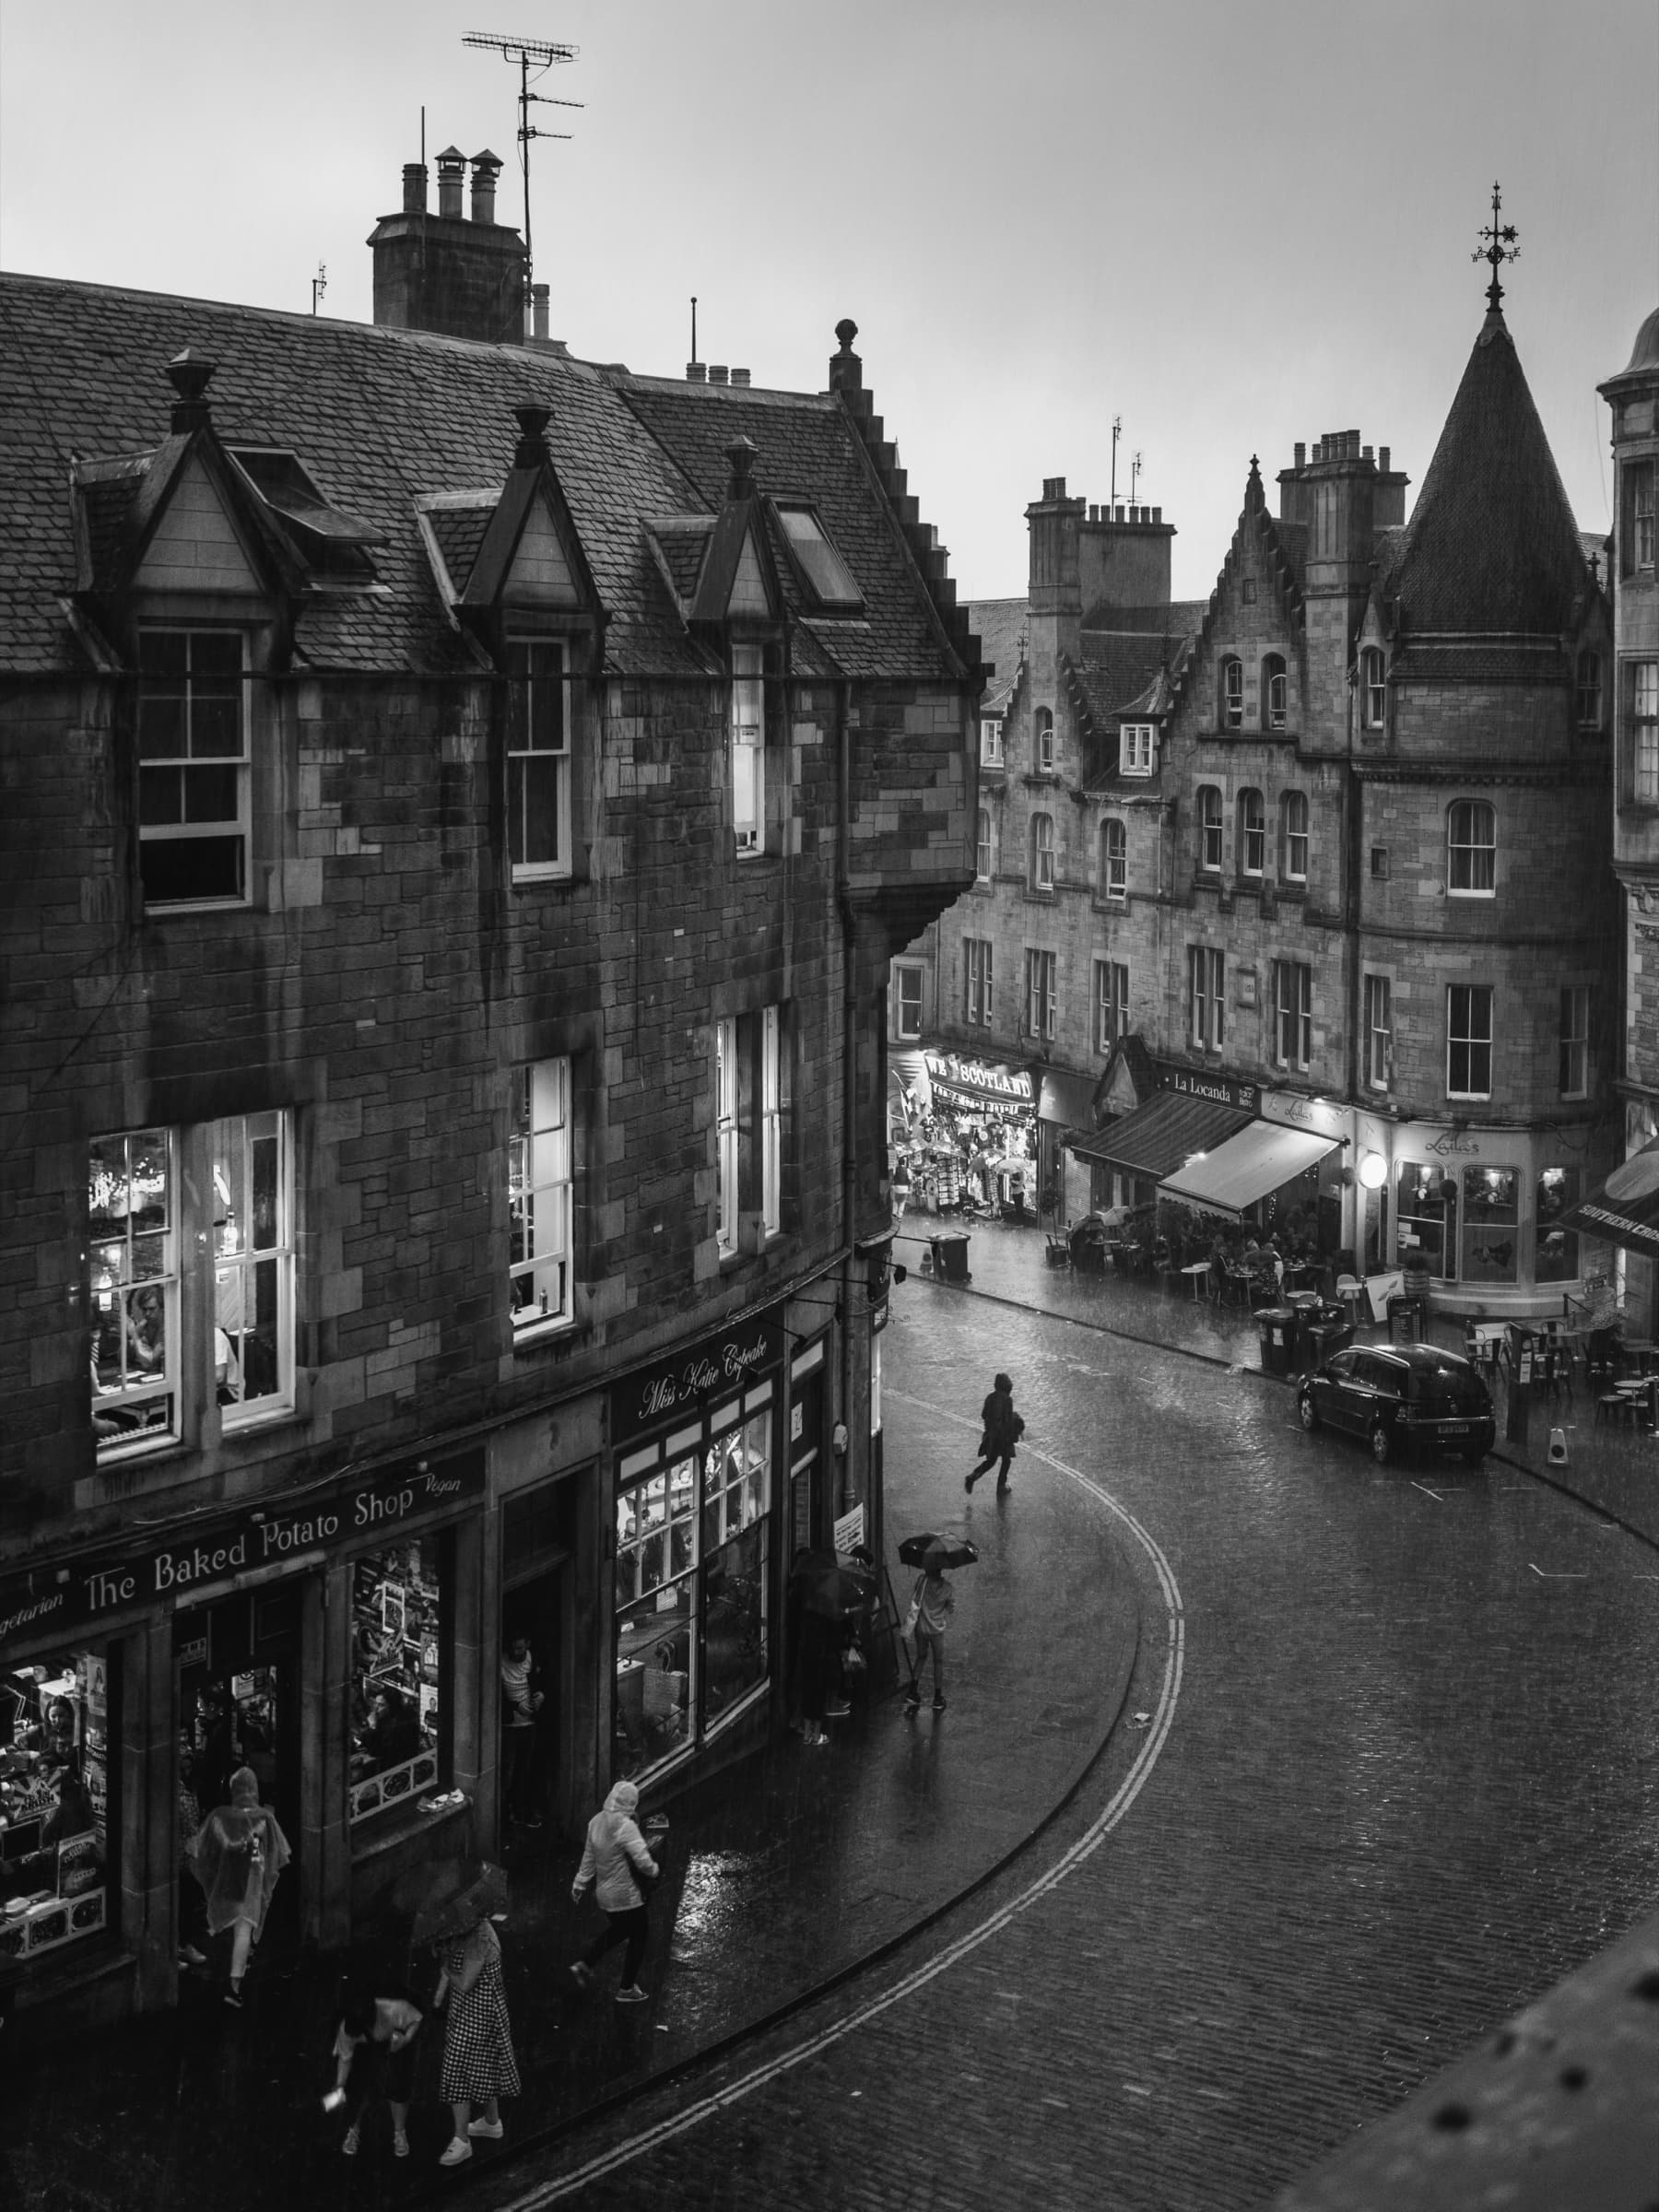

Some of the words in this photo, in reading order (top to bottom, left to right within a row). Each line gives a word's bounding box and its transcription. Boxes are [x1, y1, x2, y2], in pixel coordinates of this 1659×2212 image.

[925, 1056, 947, 1076] WE
[960, 1065, 1030, 1098] SCOTLAND
[1173, 1074, 1187, 1091] La
[1190, 1077, 1230, 1102] Locanda
[1425, 1133, 1479, 1156] Laila's
[1578, 1204, 1638, 1231] SOUTHERN
[639, 1374, 677, 1419] Miss
[679, 1359, 719, 1401] Katie
[723, 1335, 767, 1382] Cupcake
[423, 1474, 461, 1498] Vegan
[84, 1567, 135, 1611] The
[155, 1534, 246, 1591] Baked
[259, 1515, 339, 1556] Potato
[354, 1488, 414, 1525] Shop
